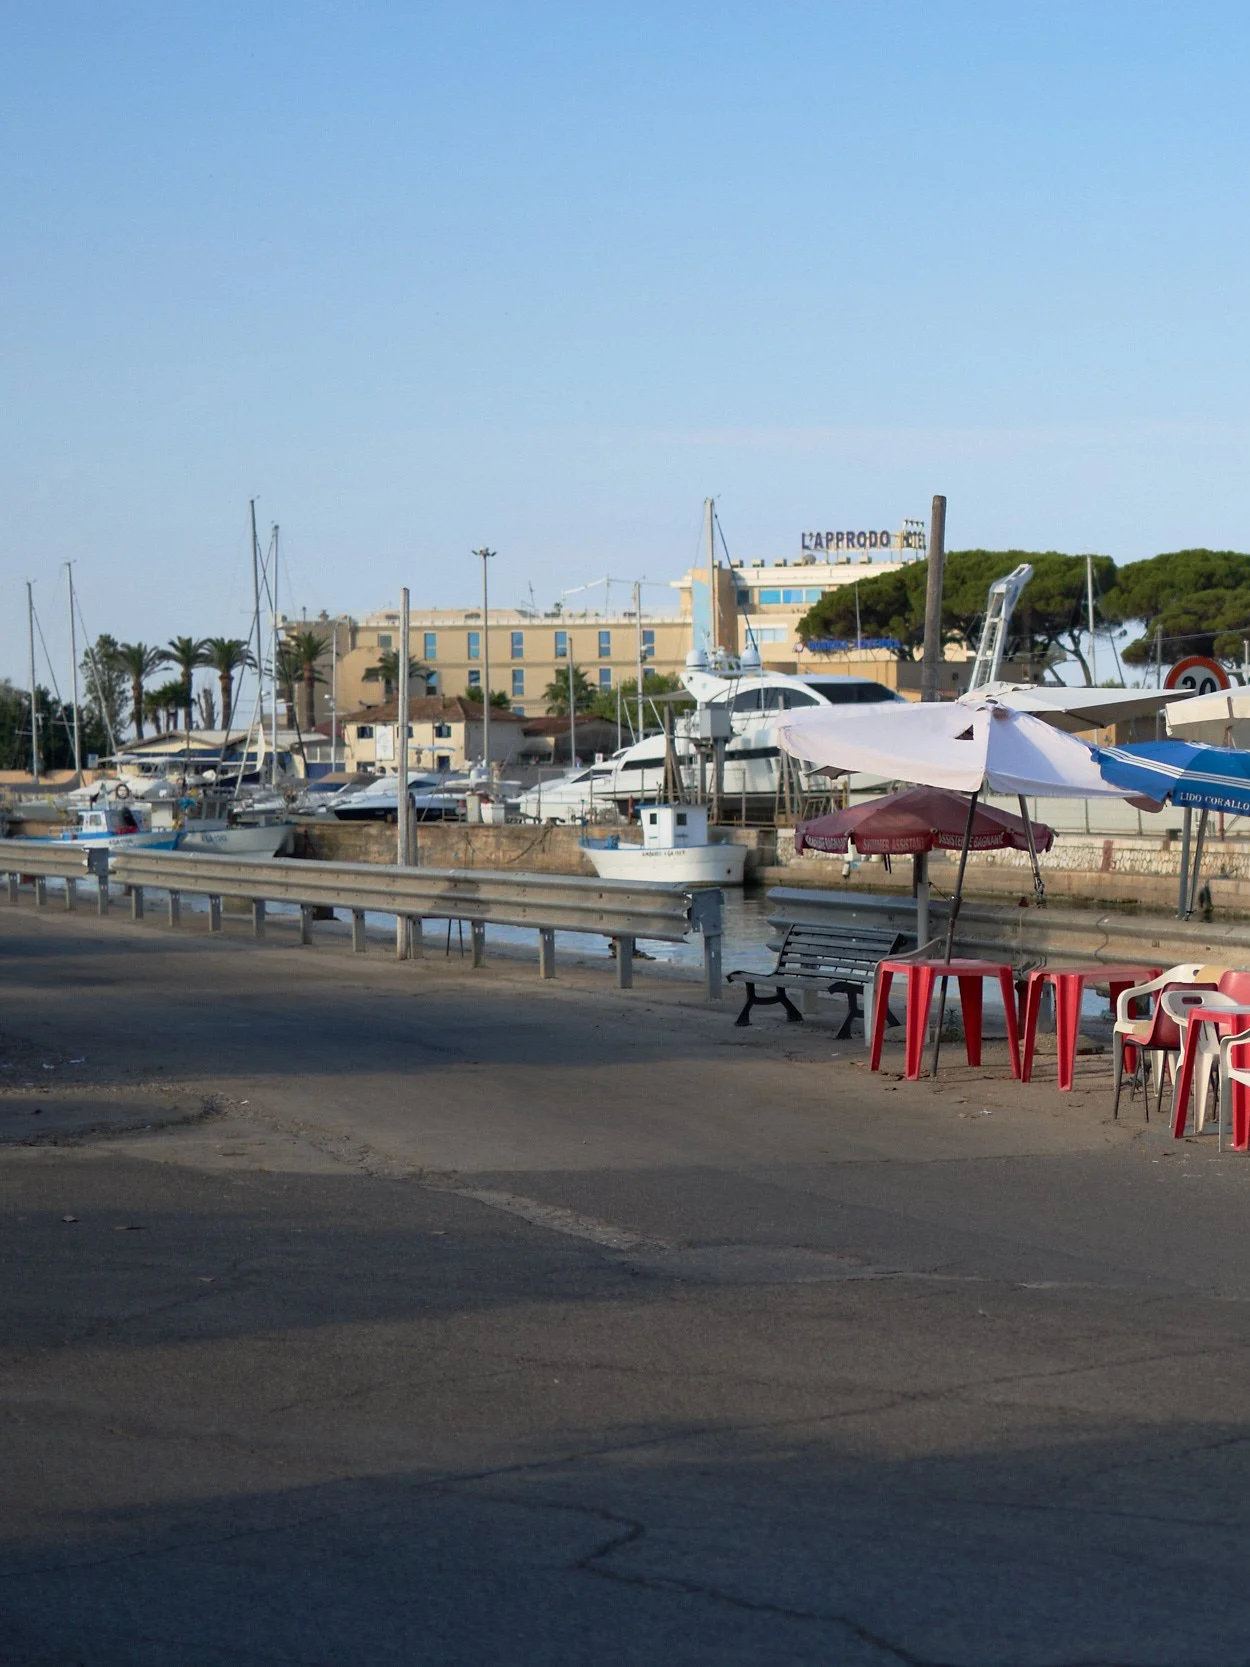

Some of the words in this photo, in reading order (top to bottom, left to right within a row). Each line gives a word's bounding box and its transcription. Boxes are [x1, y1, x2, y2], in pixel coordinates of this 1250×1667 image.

[801, 530, 890, 550] L'APPRODO
[1180, 792, 1202, 803] LIDO
[1204, 795, 1250, 811] CORALLO
